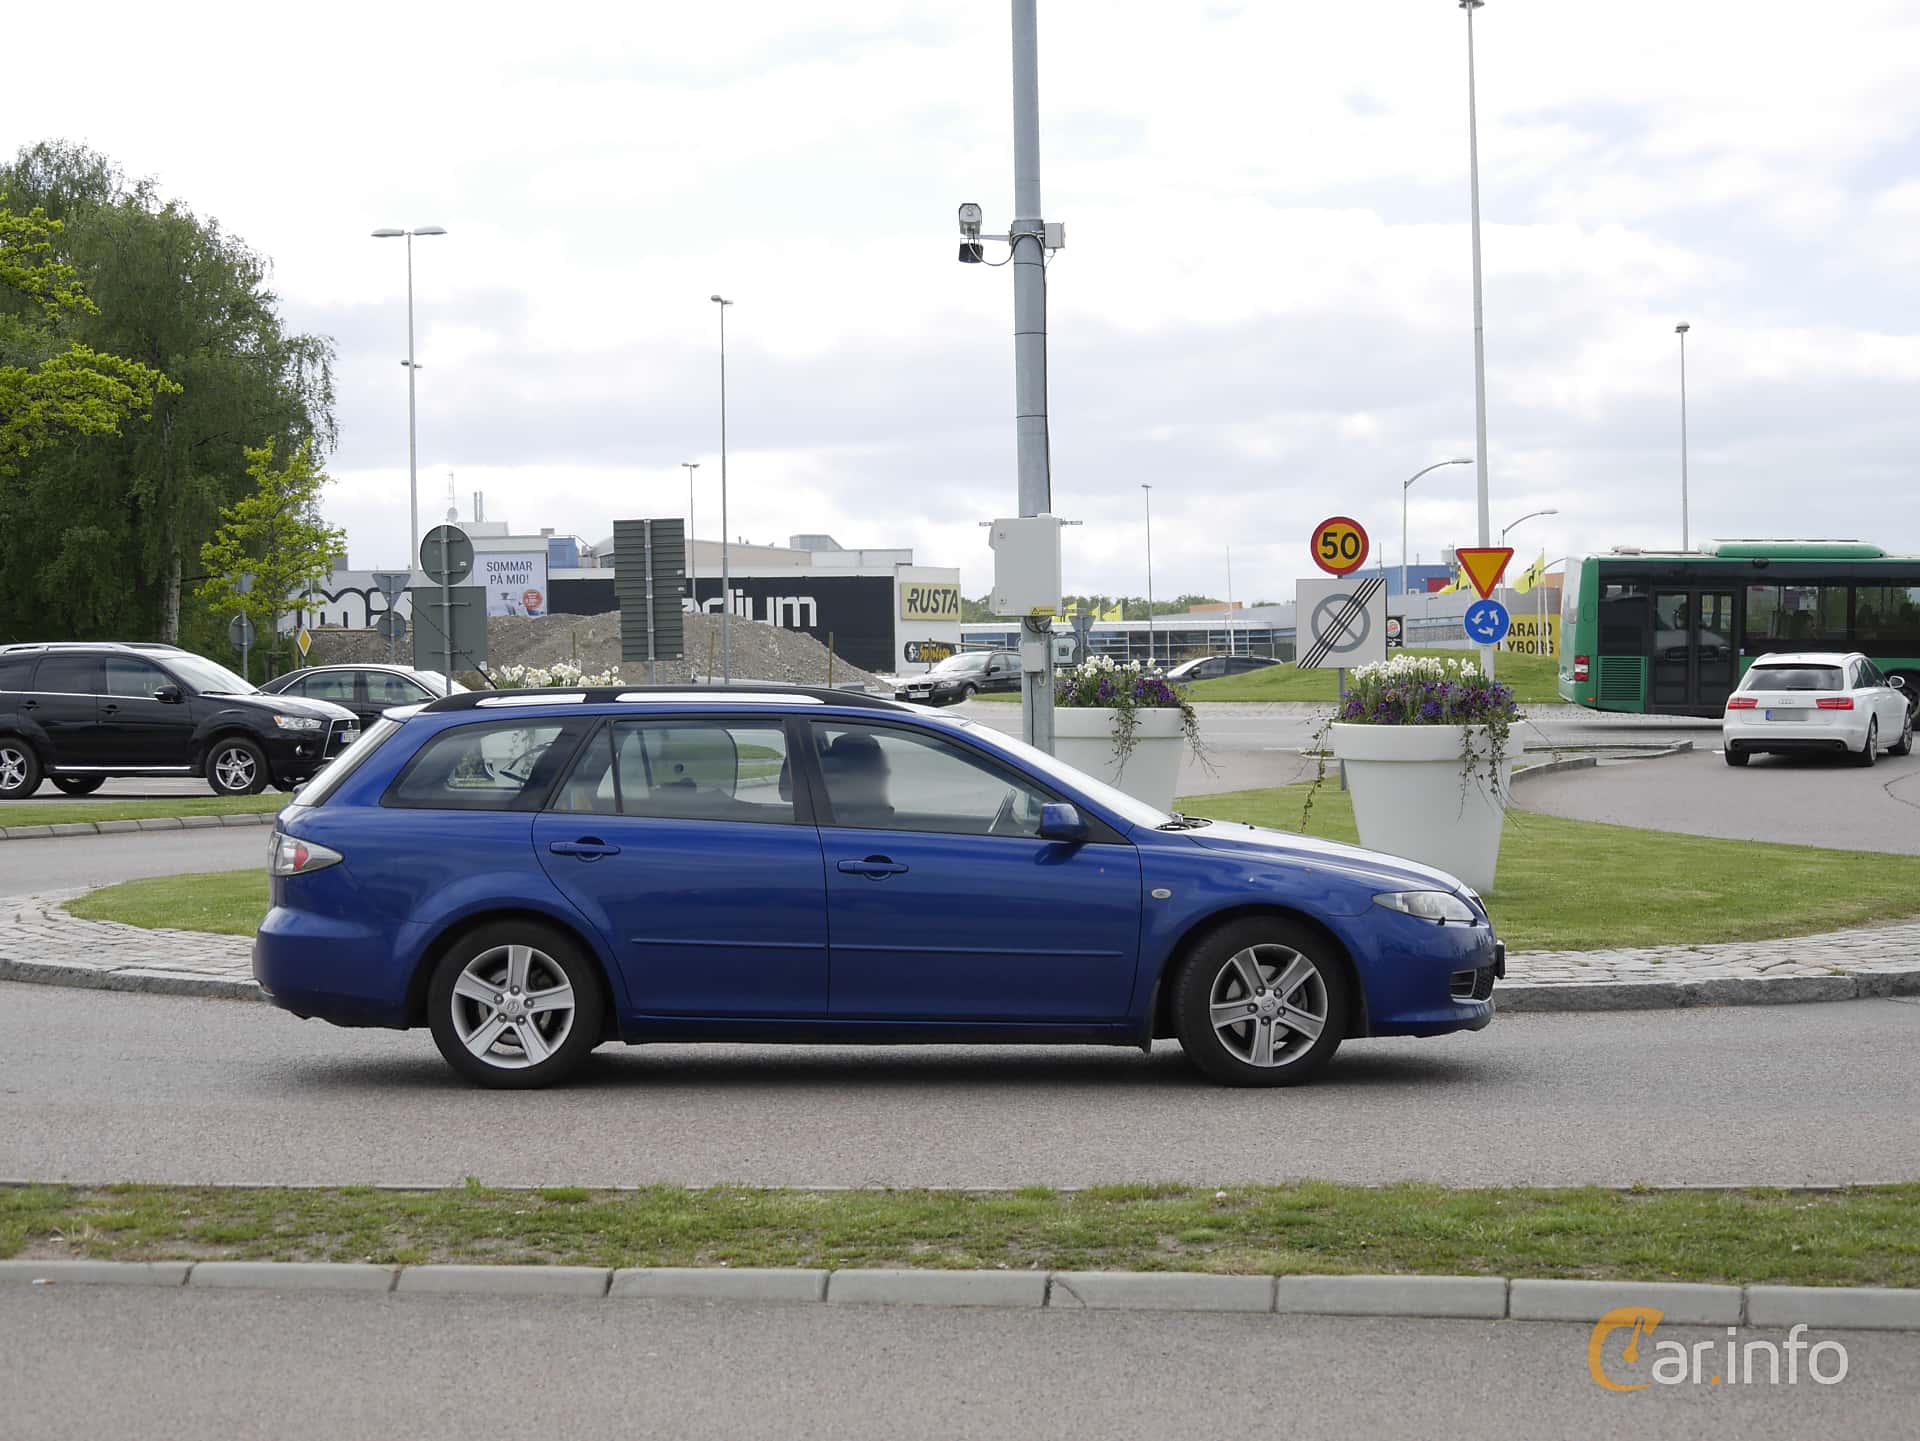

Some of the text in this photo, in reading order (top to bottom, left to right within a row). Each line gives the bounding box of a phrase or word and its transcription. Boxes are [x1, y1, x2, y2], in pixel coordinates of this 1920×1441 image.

[1322, 532, 1360, 559] 50
[486, 560, 533, 572] SOMMAR
[490, 573, 529, 585] PÅ MIO!
[907, 588, 958, 614] RUSTA
[1507, 622, 1552, 636] ARALD
[1497, 640, 1554, 655] YBORG
